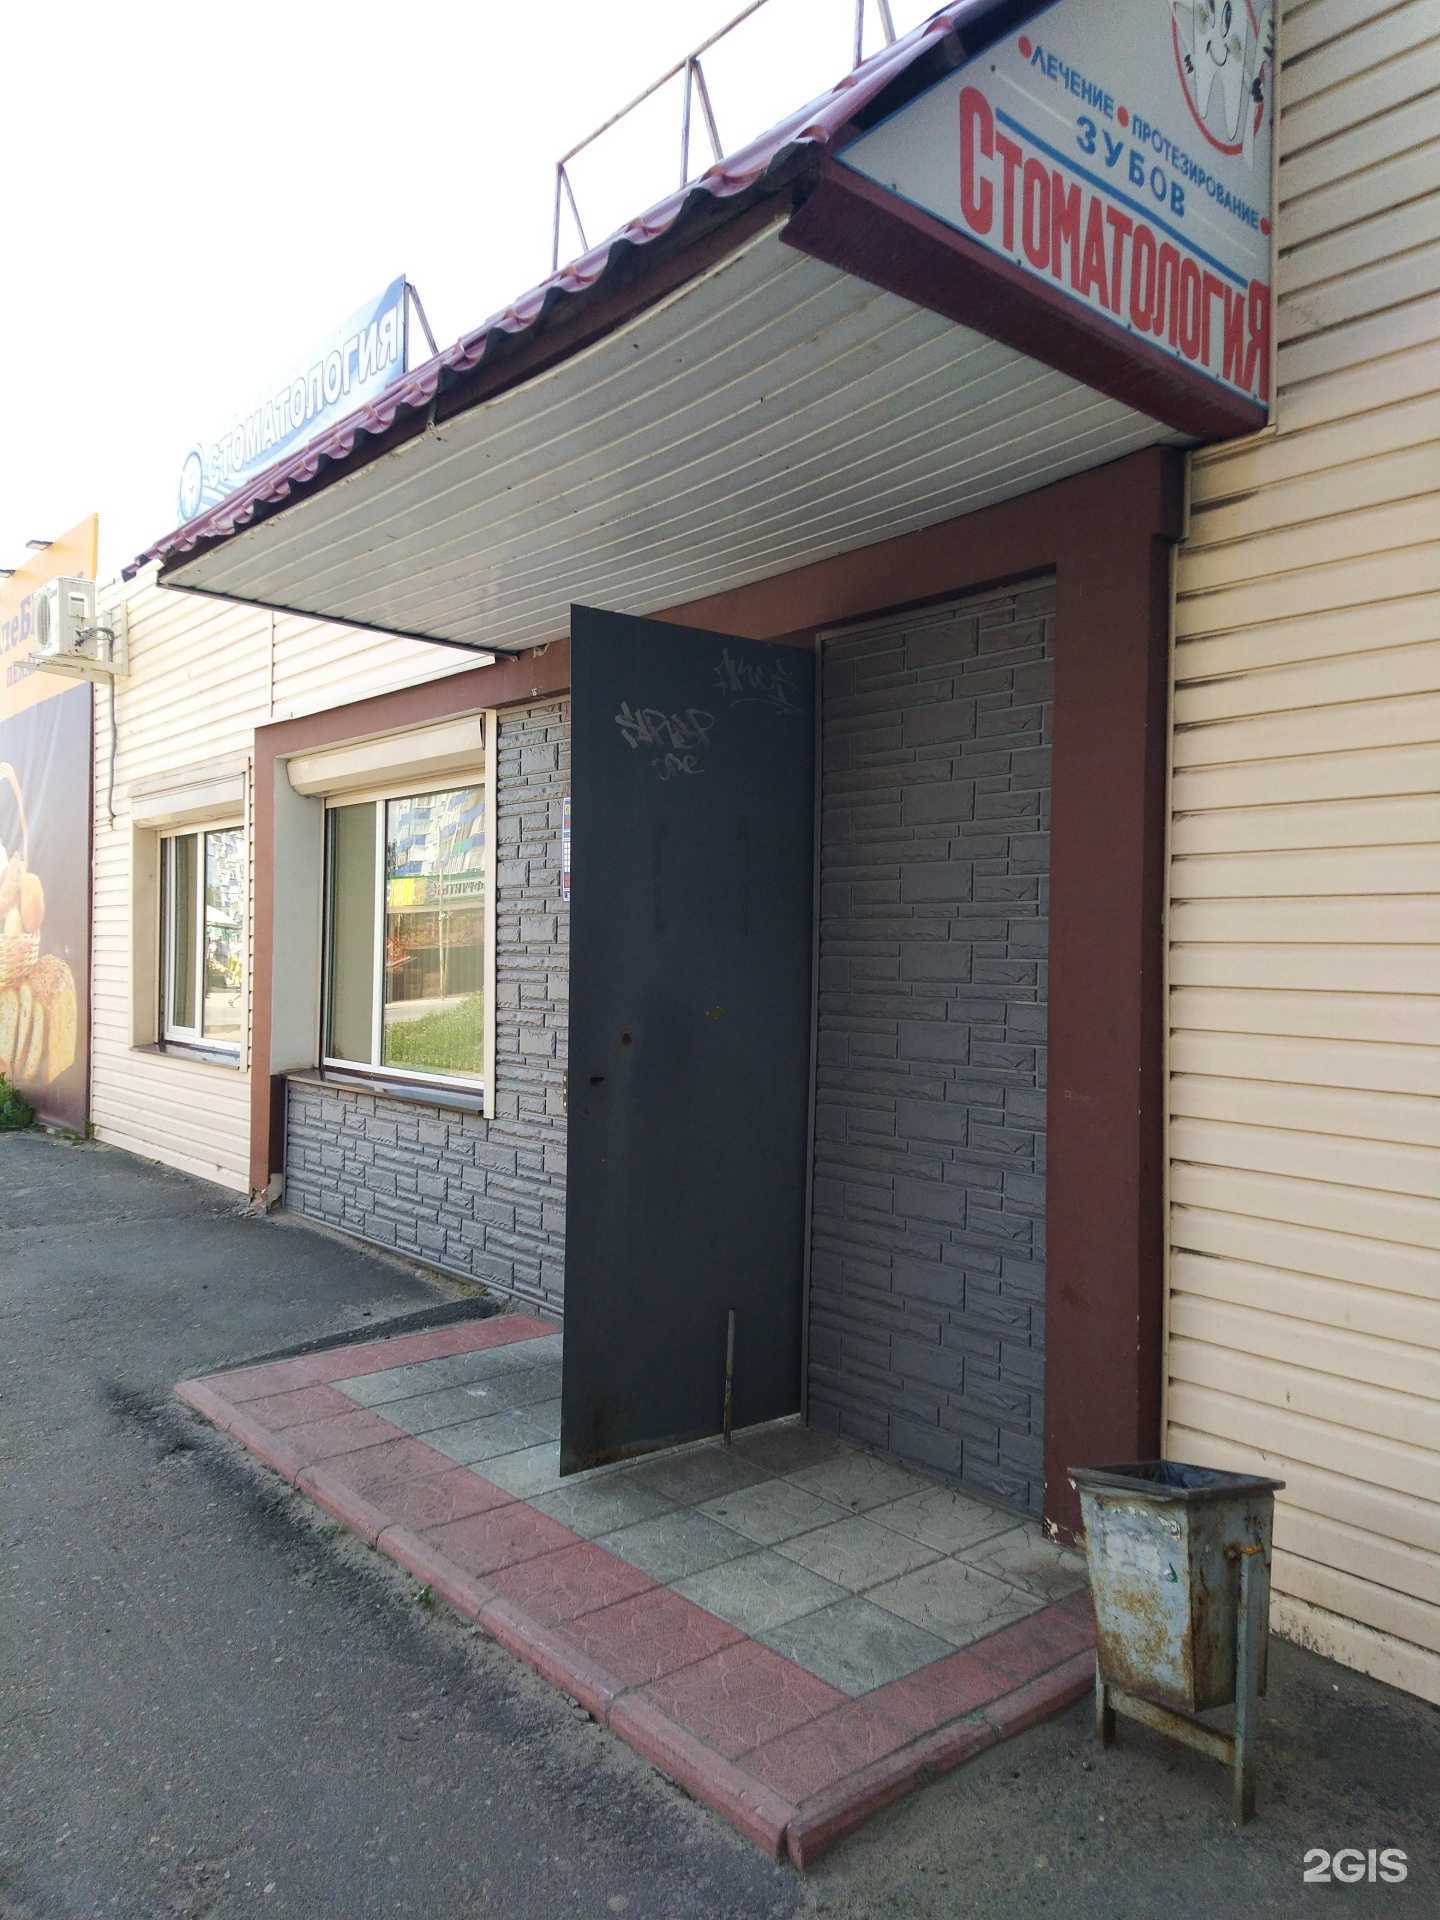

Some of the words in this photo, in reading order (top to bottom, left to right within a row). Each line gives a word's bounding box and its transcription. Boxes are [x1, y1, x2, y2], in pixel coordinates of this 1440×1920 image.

[1031, 45, 1115, 120] ЛЕЧЕНИЕ
[1132, 114, 1260, 230] ПРОТЕЗИРОВАНИЕ
[1076, 115, 1185, 218] ЗУБОВ
[959, 86, 1270, 401] СТОМАТОЛОГИЯ
[206, 304, 399, 489] СТОМАТОЛОГИЯ
